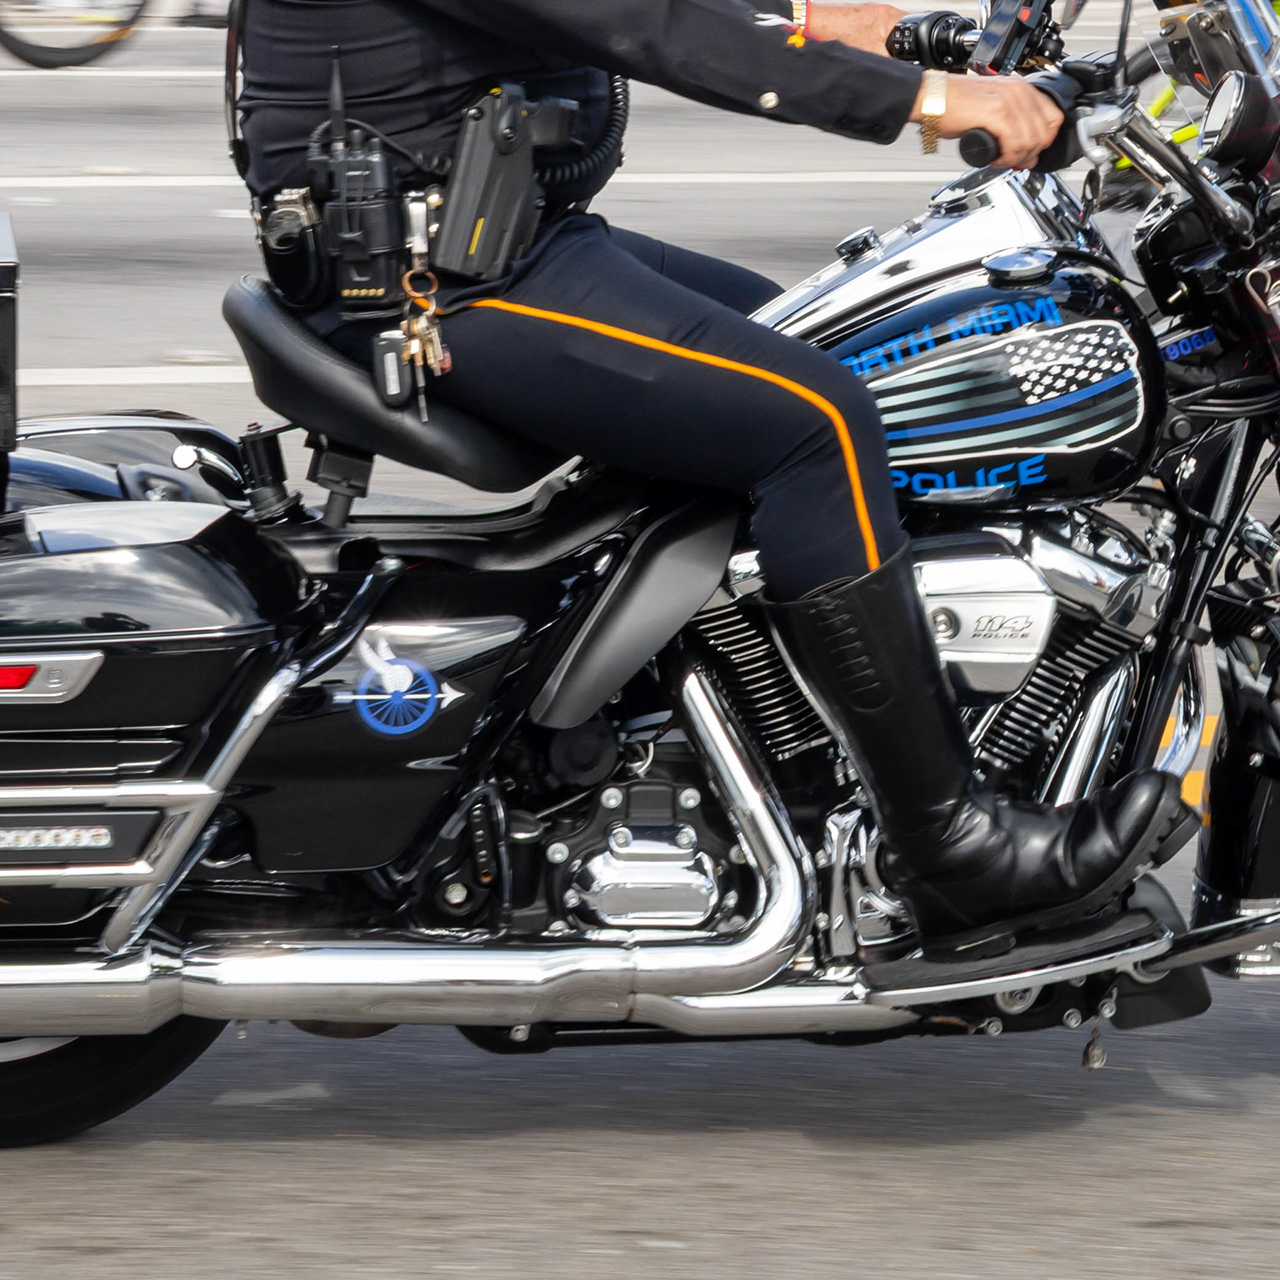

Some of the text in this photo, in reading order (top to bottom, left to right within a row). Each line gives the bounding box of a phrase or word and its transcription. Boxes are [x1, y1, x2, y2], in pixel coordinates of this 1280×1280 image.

[840, 296, 1063, 376] ORTH MIAMI
[890, 453, 1049, 495] POLICE
[974, 615, 1033, 632] 114
